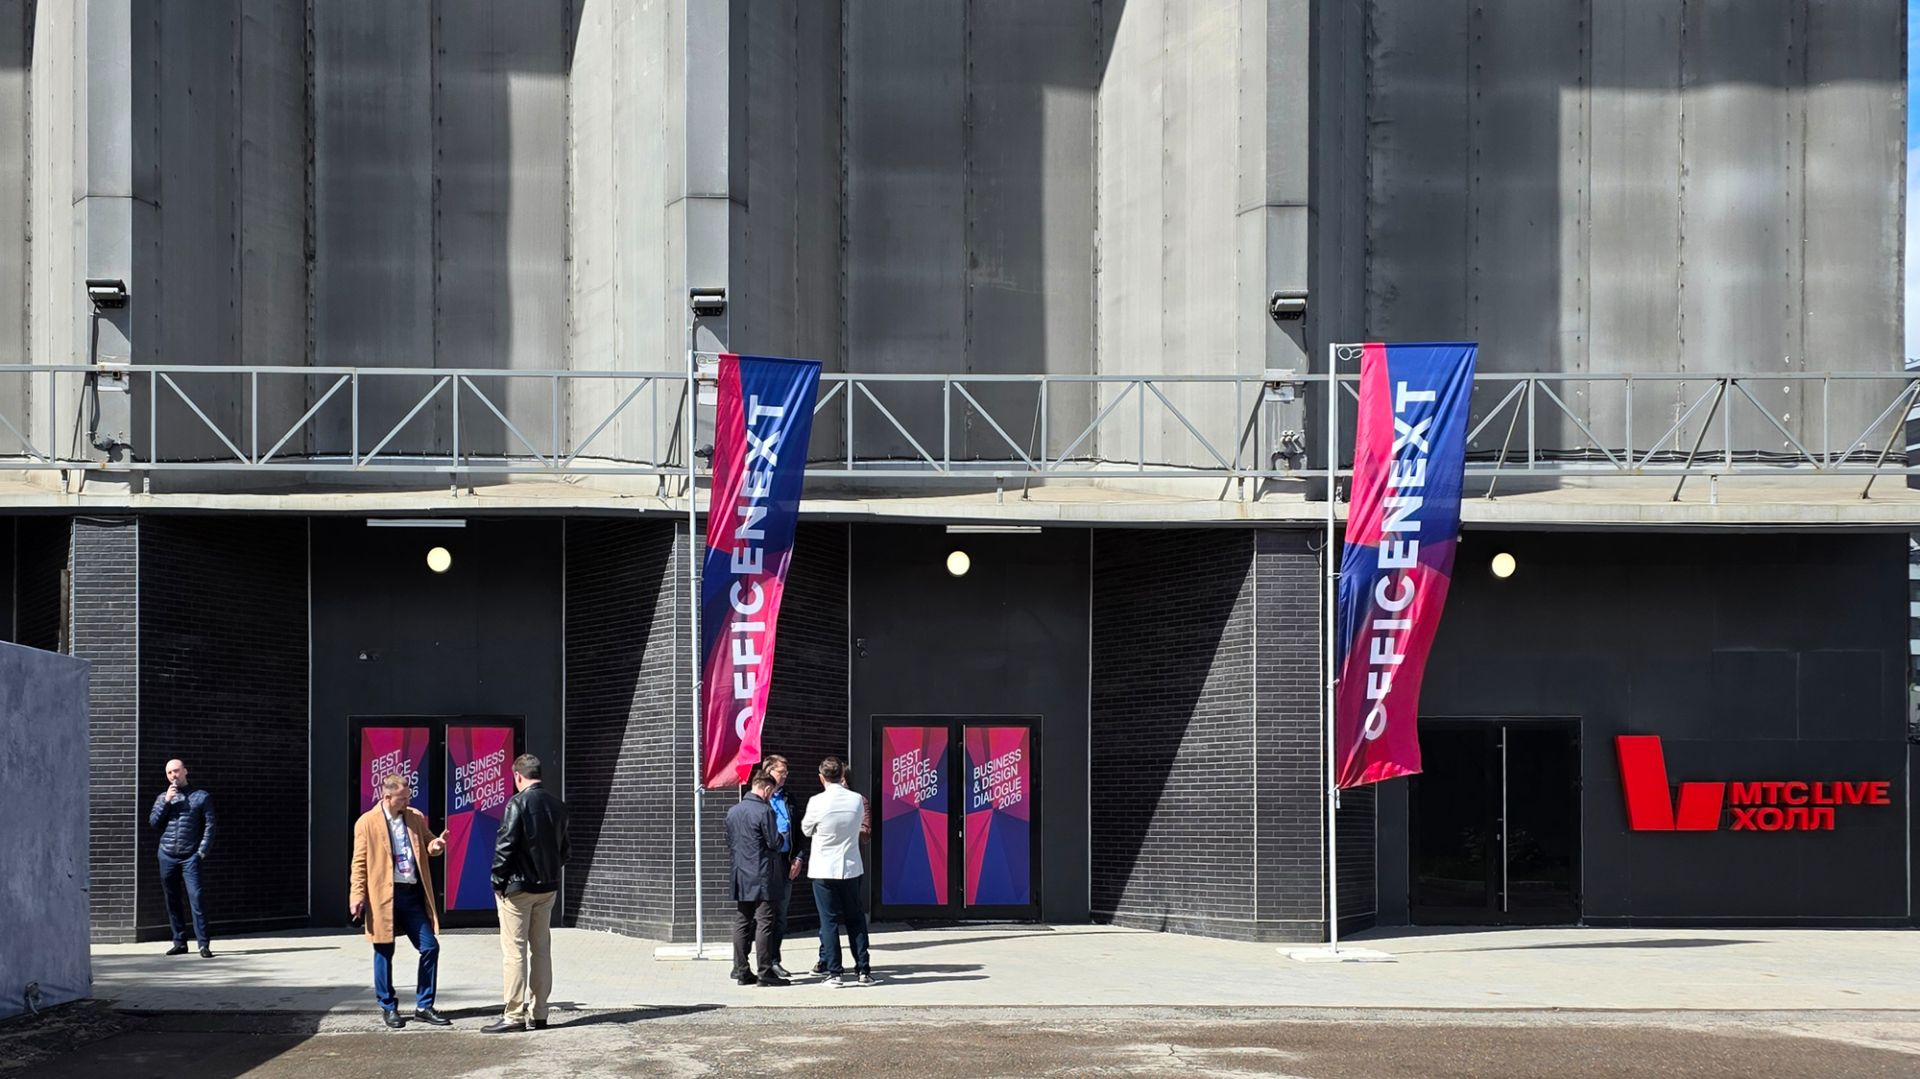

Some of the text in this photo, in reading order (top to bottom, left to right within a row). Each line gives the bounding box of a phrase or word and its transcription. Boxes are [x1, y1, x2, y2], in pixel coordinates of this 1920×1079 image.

[1363, 380, 1437, 741] OFFICENEXT
[371, 749, 401, 774] BEST
[455, 749, 505, 780] BUSINESS
[892, 748, 920, 772] BEST
[892, 758, 931, 786] OFFICE
[973, 748, 1022, 780] BUSINESS
[454, 766, 501, 795] & DESIGN
[892, 769, 938, 801] AWARDS
[973, 763, 1018, 794] & DESIGN
[973, 777, 1022, 808] DIALOGUE
[455, 779, 505, 810] DIALOGUE
[480, 795, 505, 812] 2026
[914, 784, 938, 804] 2026
[998, 790, 1022, 810] 2026
[1813, 781, 1891, 805] LIVE
[1729, 806, 1836, 831] ХОЛЛ
